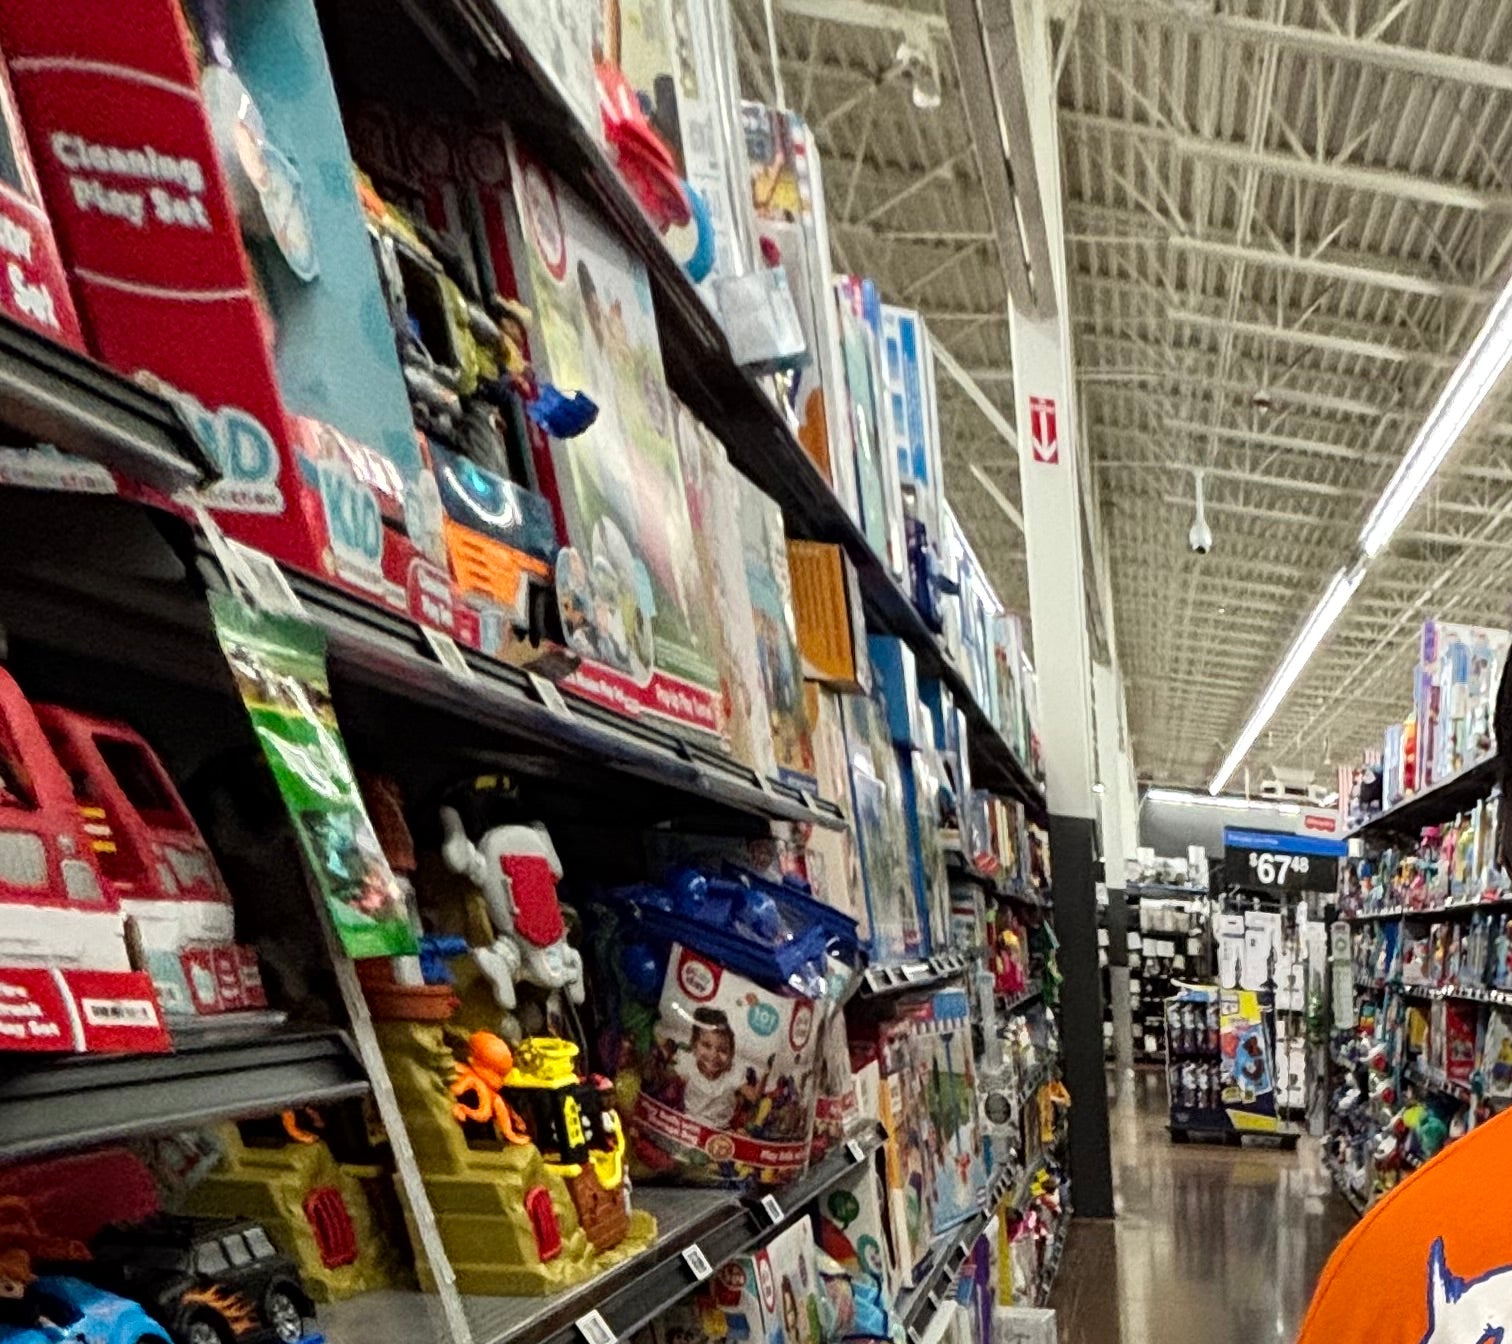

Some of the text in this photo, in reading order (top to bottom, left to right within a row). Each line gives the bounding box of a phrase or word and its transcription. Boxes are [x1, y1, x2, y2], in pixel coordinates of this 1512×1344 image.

[50, 130, 206, 194] Cleaning
[68, 175, 213, 234] Play Set
